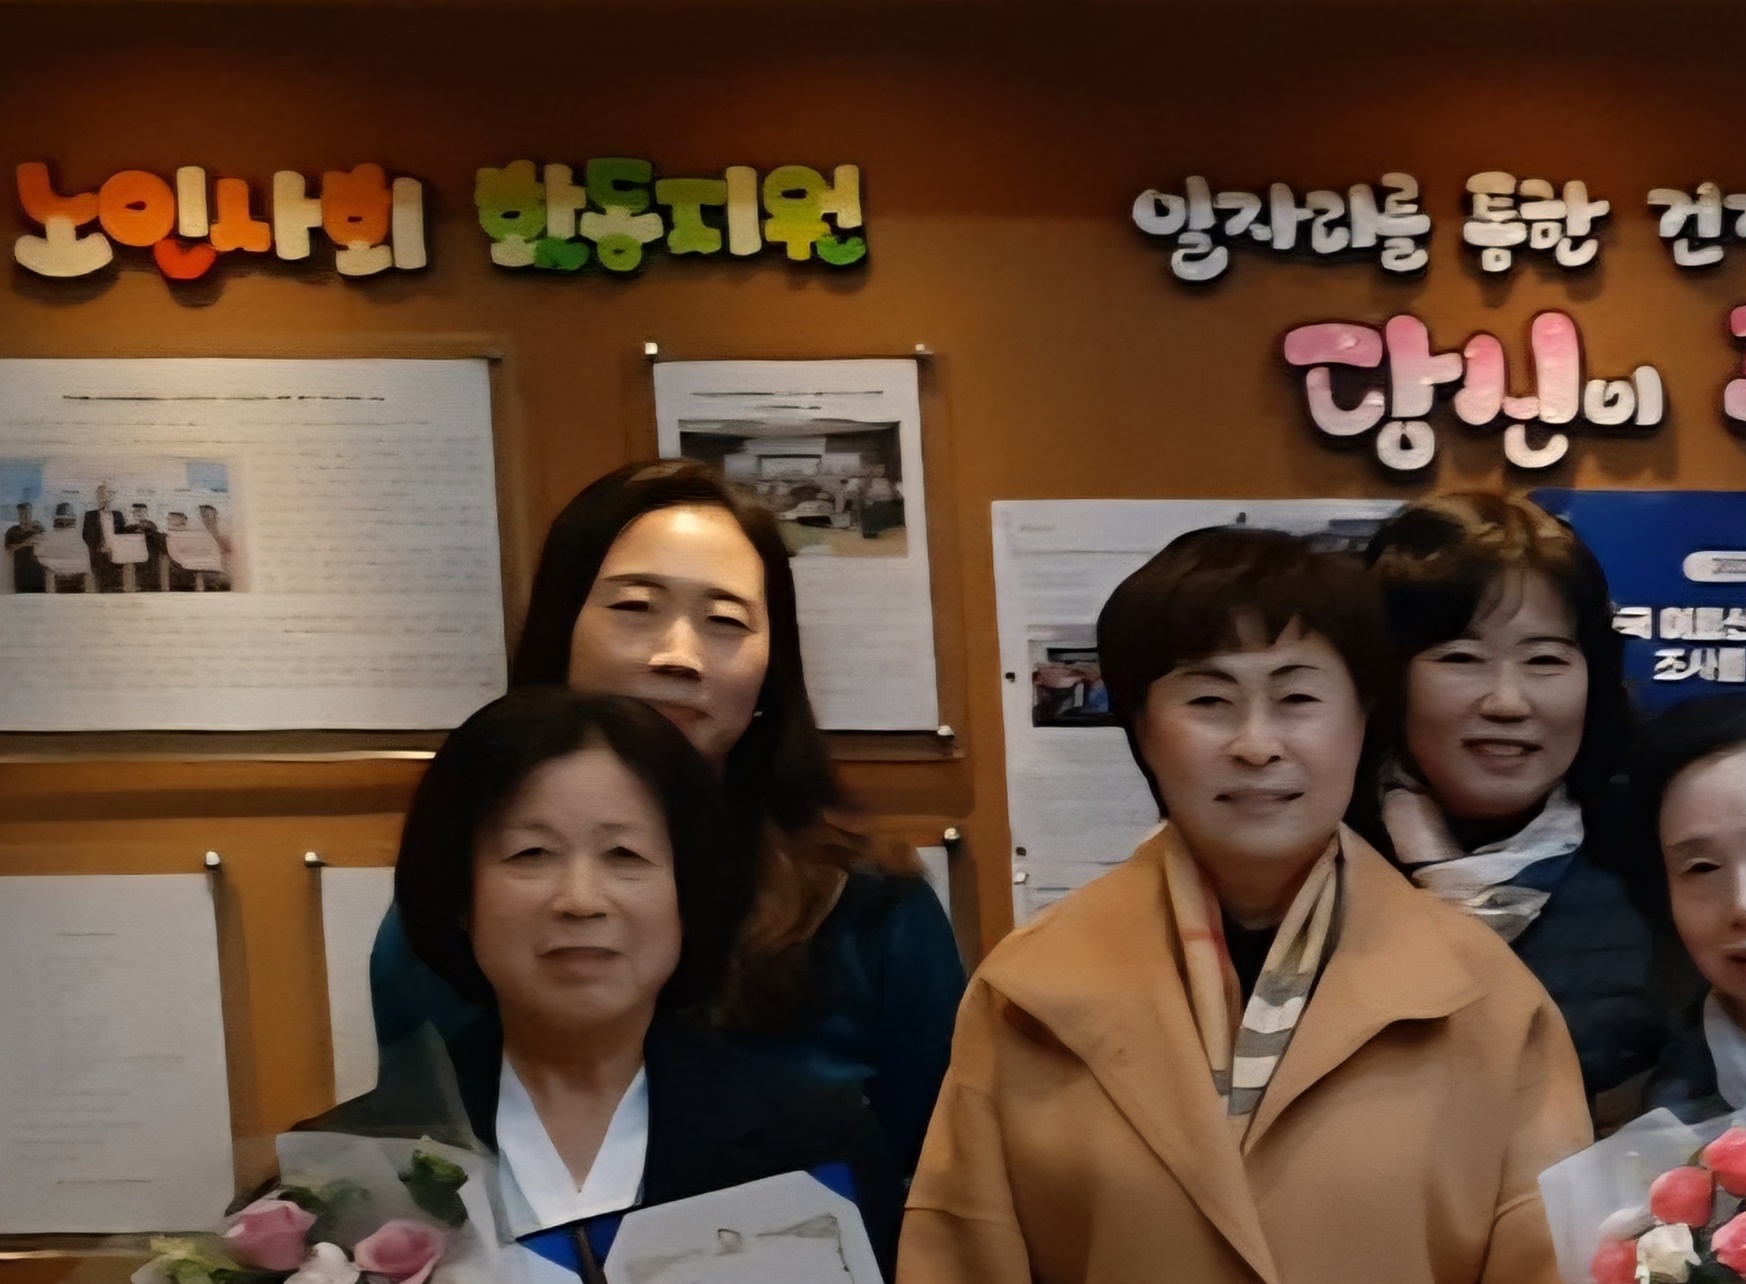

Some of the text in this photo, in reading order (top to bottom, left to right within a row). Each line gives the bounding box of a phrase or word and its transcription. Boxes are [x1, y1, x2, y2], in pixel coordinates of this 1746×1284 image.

[15, 158, 867, 280] 노인사회 활동지원
[1132, 172, 1431, 281] 일자리를
[1463, 171, 1610, 272] 통한
[1284, 312, 1663, 470] 당신이
